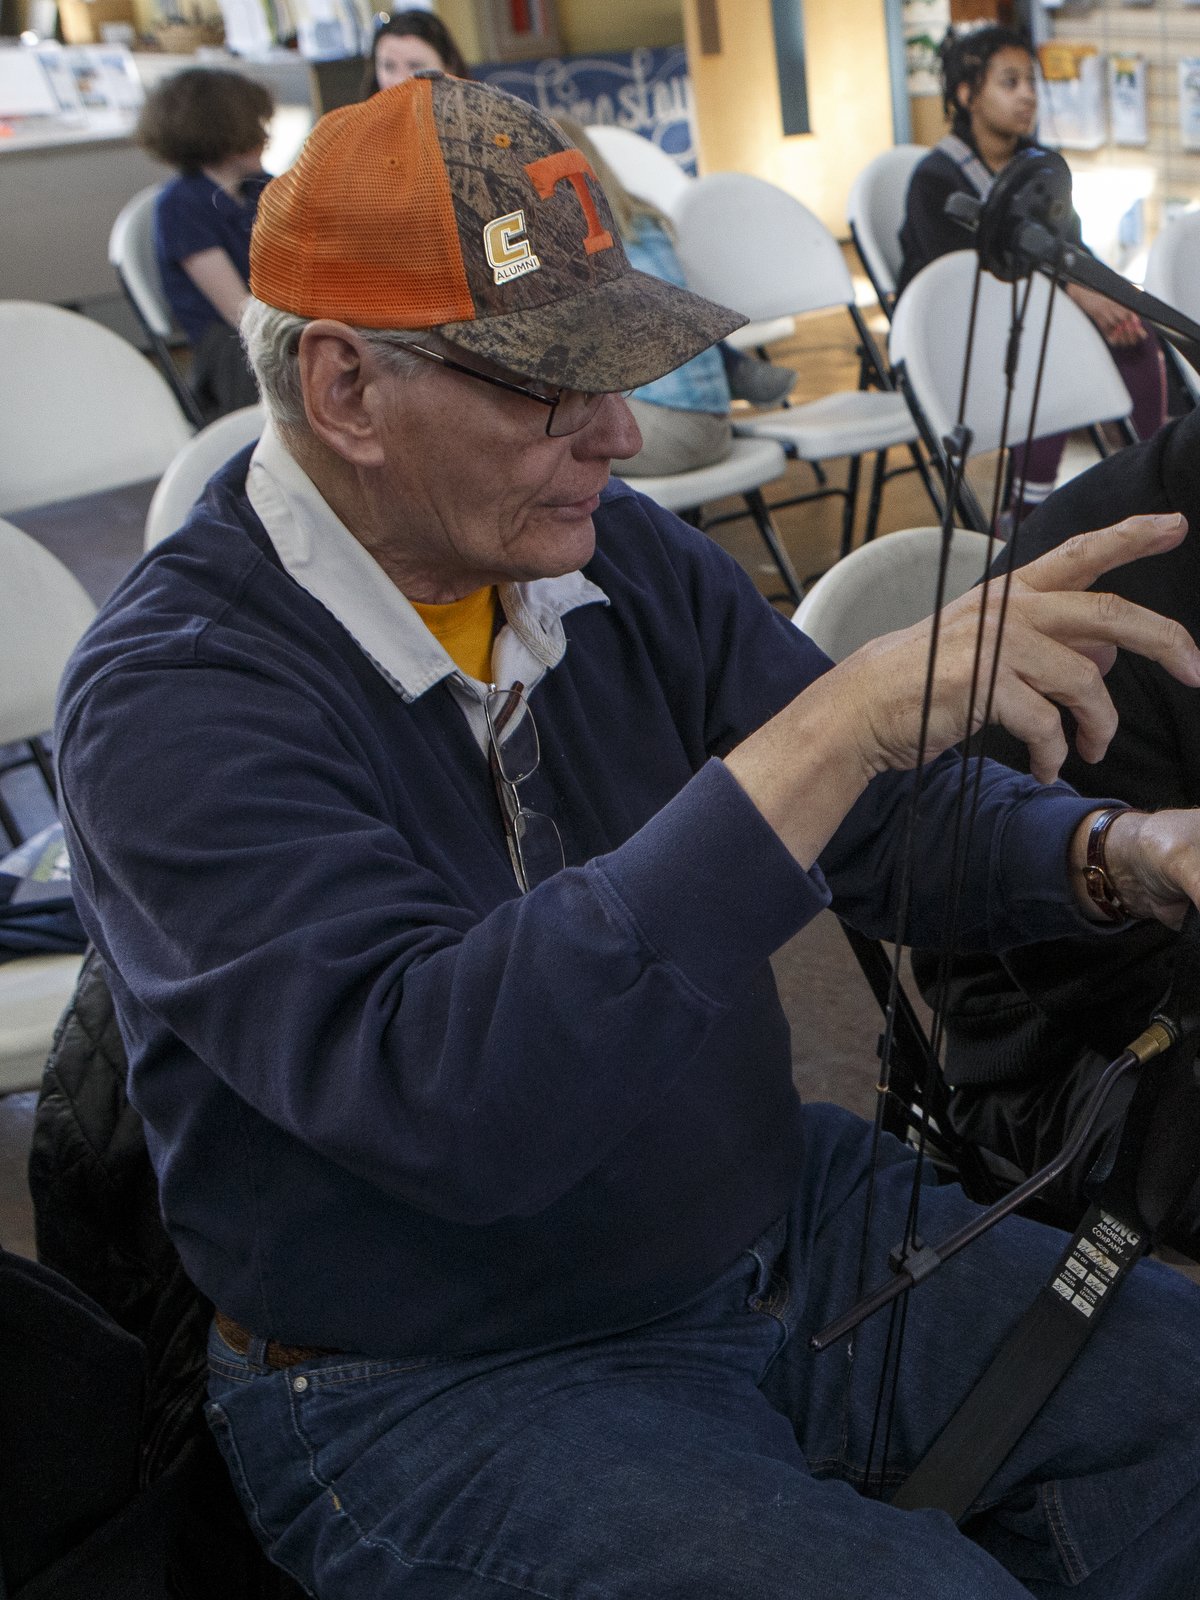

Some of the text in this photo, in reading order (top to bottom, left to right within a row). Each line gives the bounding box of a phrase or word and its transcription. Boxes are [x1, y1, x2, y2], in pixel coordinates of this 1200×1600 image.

[523, 148, 614, 256] T
[483, 209, 531, 269] C
[496, 259, 538, 282] ALUMNI
[1092, 1226, 1124, 1255] COMPANY
[1096, 1222, 1127, 1246] ARCHERY
[1100, 1209, 1141, 1246] WING
[1059, 1272, 1076, 1288] LENGTH
[1079, 1289, 1096, 1305] LENGTH
